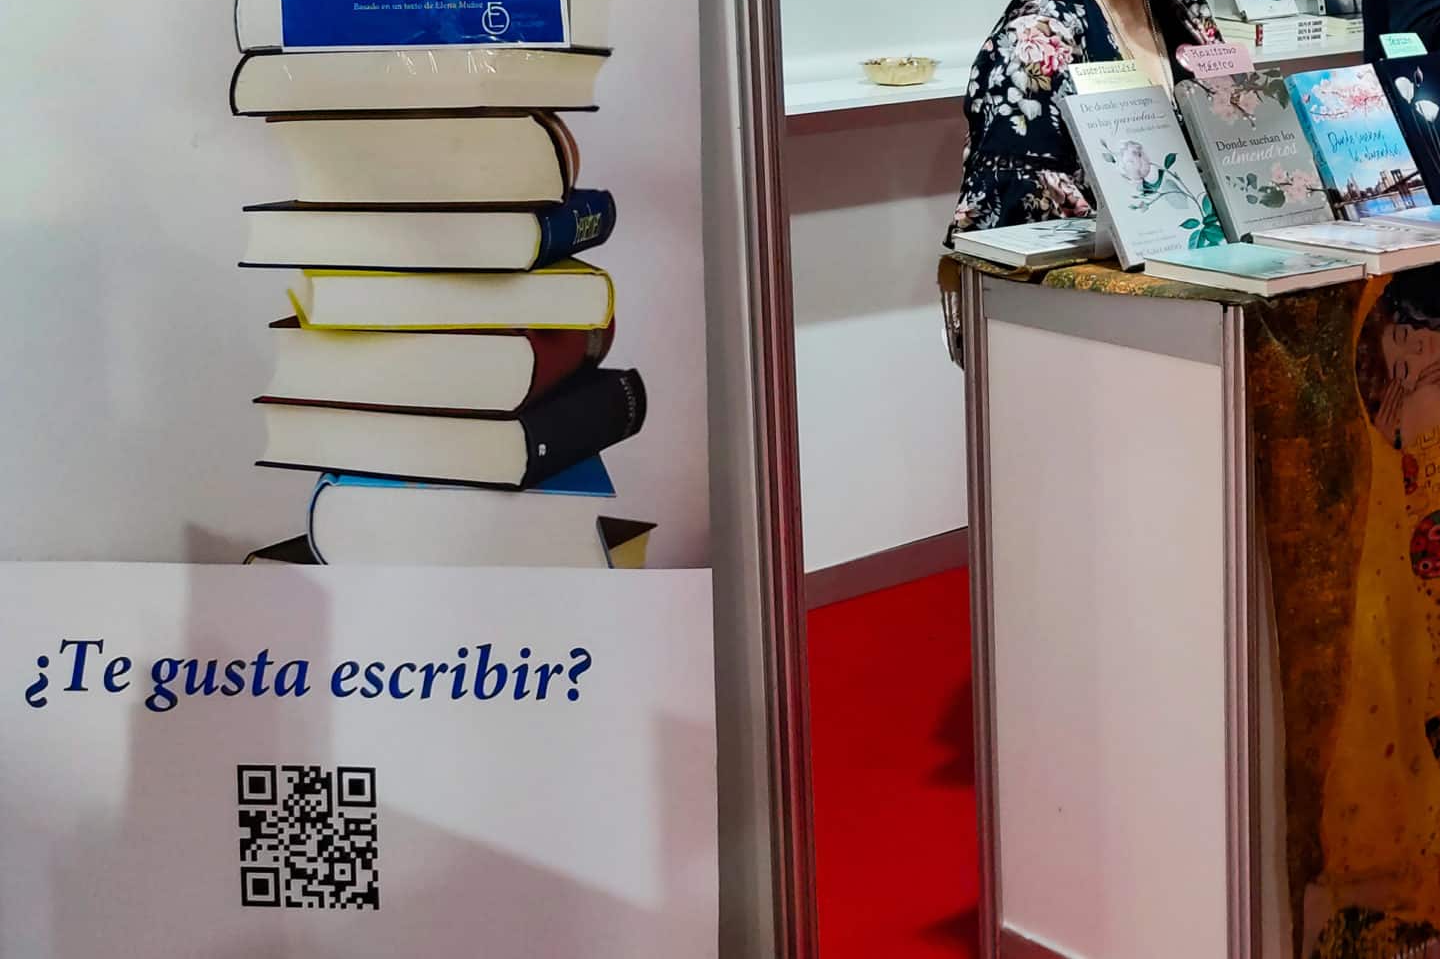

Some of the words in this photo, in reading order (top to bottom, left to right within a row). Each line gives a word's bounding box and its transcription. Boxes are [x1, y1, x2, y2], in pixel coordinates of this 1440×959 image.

[1216, 137, 1248, 152] Donde
[25, 639, 132, 709] ¿Te
[145, 649, 310, 712] gusta
[330, 643, 593, 703] escribir?
